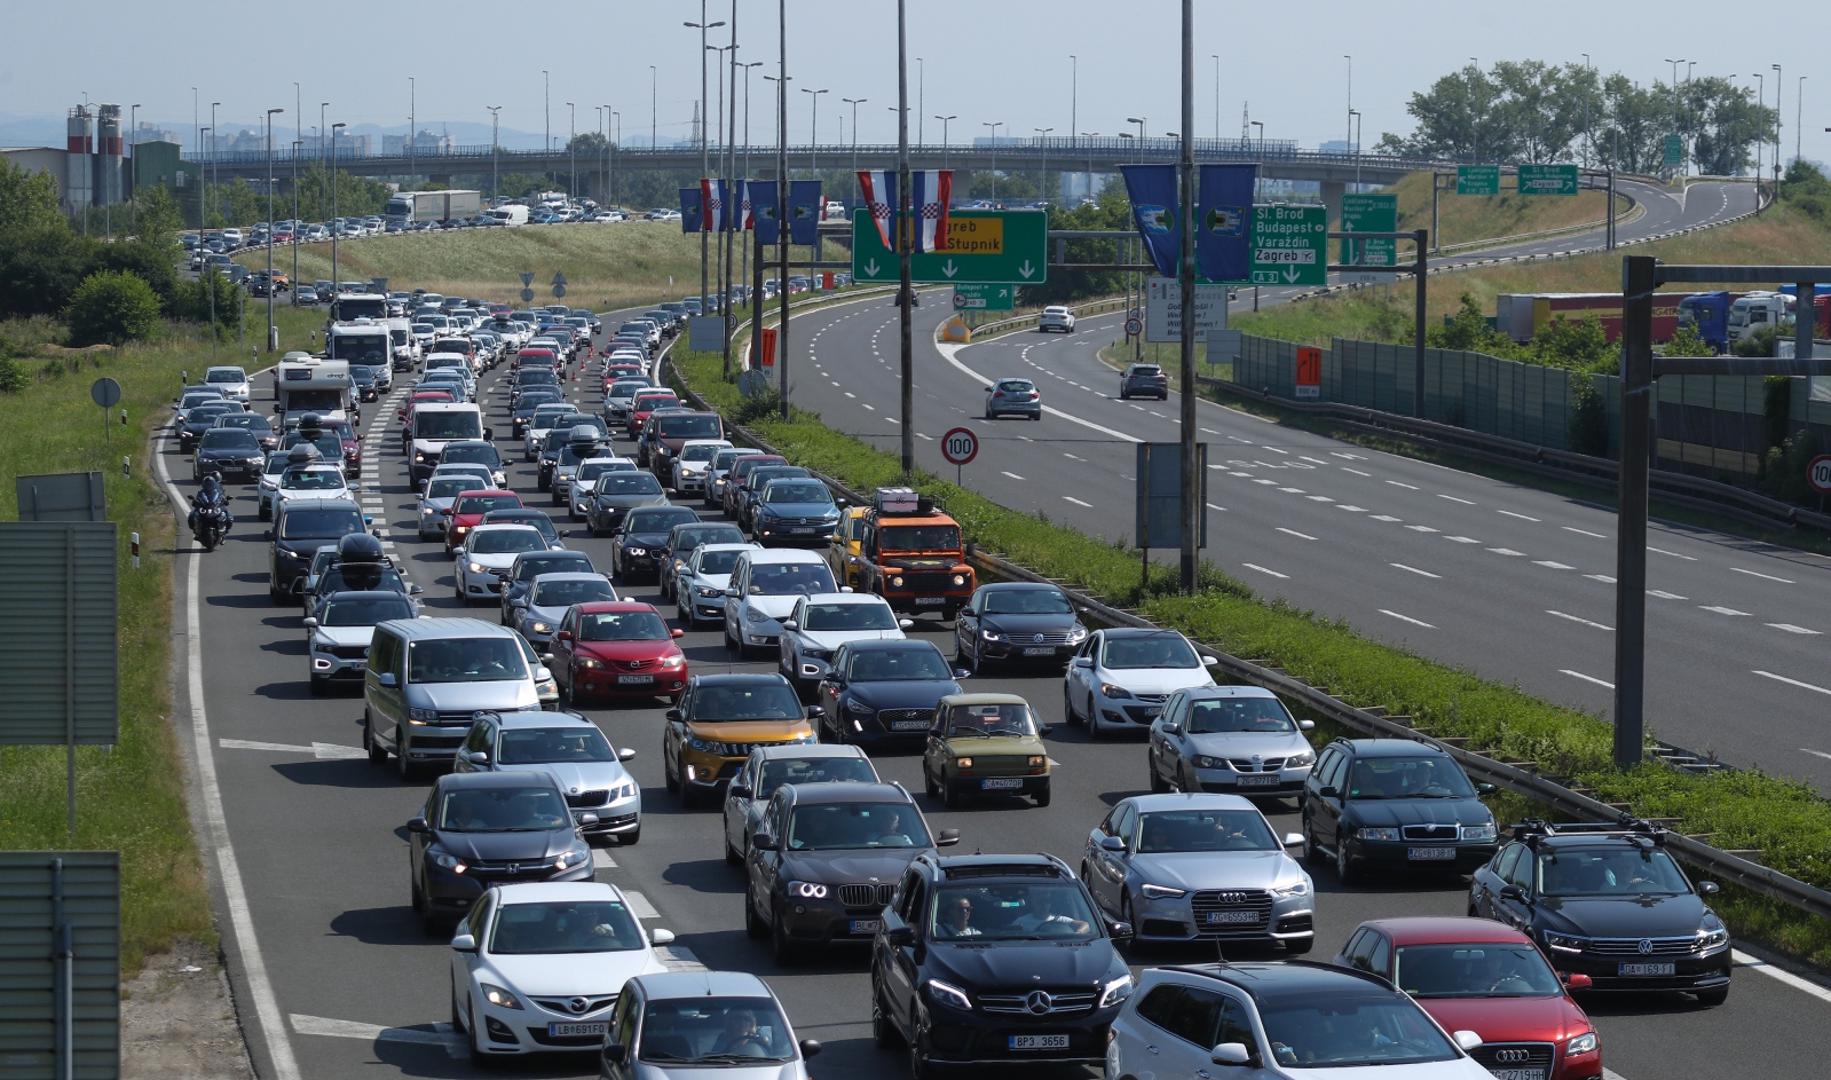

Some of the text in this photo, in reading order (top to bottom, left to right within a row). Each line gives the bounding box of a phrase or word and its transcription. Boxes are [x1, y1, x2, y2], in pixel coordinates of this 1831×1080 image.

[1257, 208, 1304, 220] Sl. Brod
[947, 220, 977, 235] reb
[1256, 221, 1312, 234] Budapest
[947, 237, 1001, 252] Stupnik
[1256, 235, 1310, 248] Varaždin
[1255, 249, 1298, 263] Zagreb
[949, 438, 972, 455] 100
[558, 1025, 570, 1035] LB
[1041, 1036, 1065, 1047] 3656
